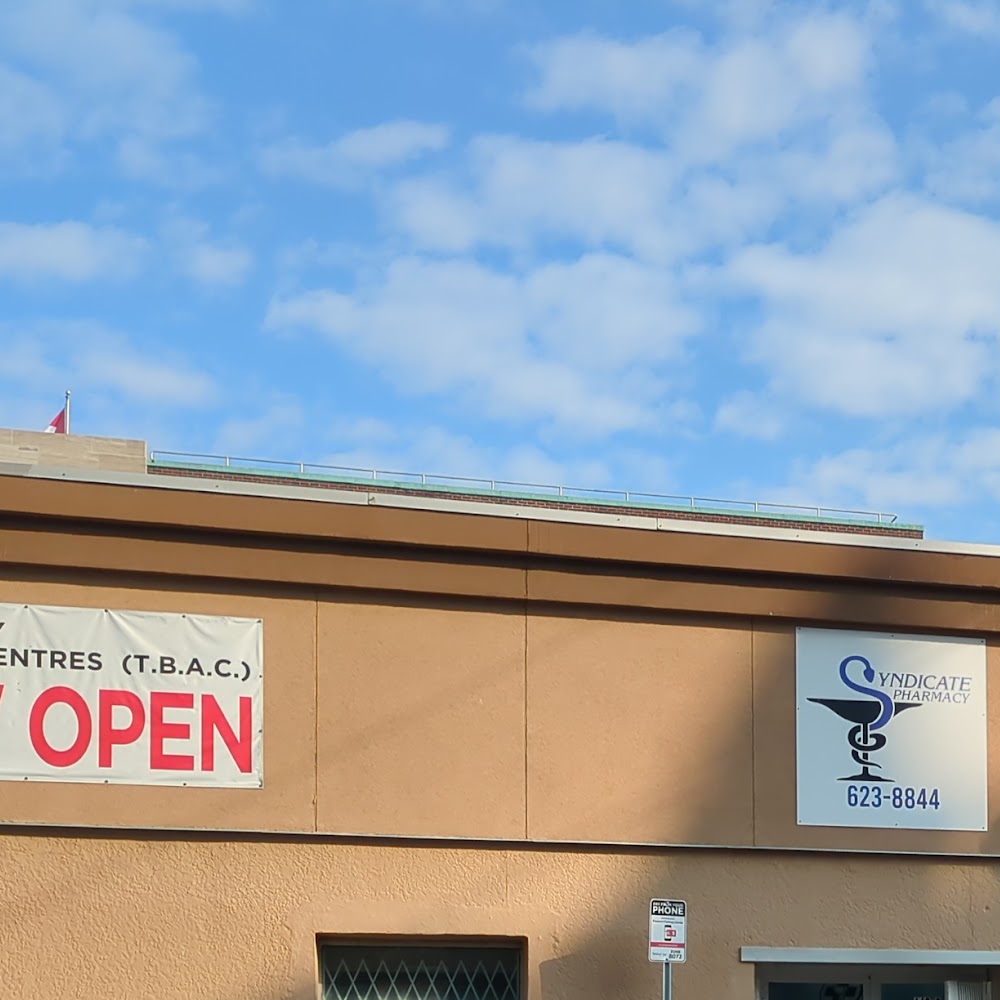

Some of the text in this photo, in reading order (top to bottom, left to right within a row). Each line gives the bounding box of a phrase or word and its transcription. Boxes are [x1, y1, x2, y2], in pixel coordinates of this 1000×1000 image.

[122, 654, 251, 682] (T.B.A.C.)
[893, 689, 971, 704] PHARMACY
[29, 686, 253, 774] OPEN
[847, 785, 940, 810] 623-8844
[652, 905, 684, 915] PHONE
